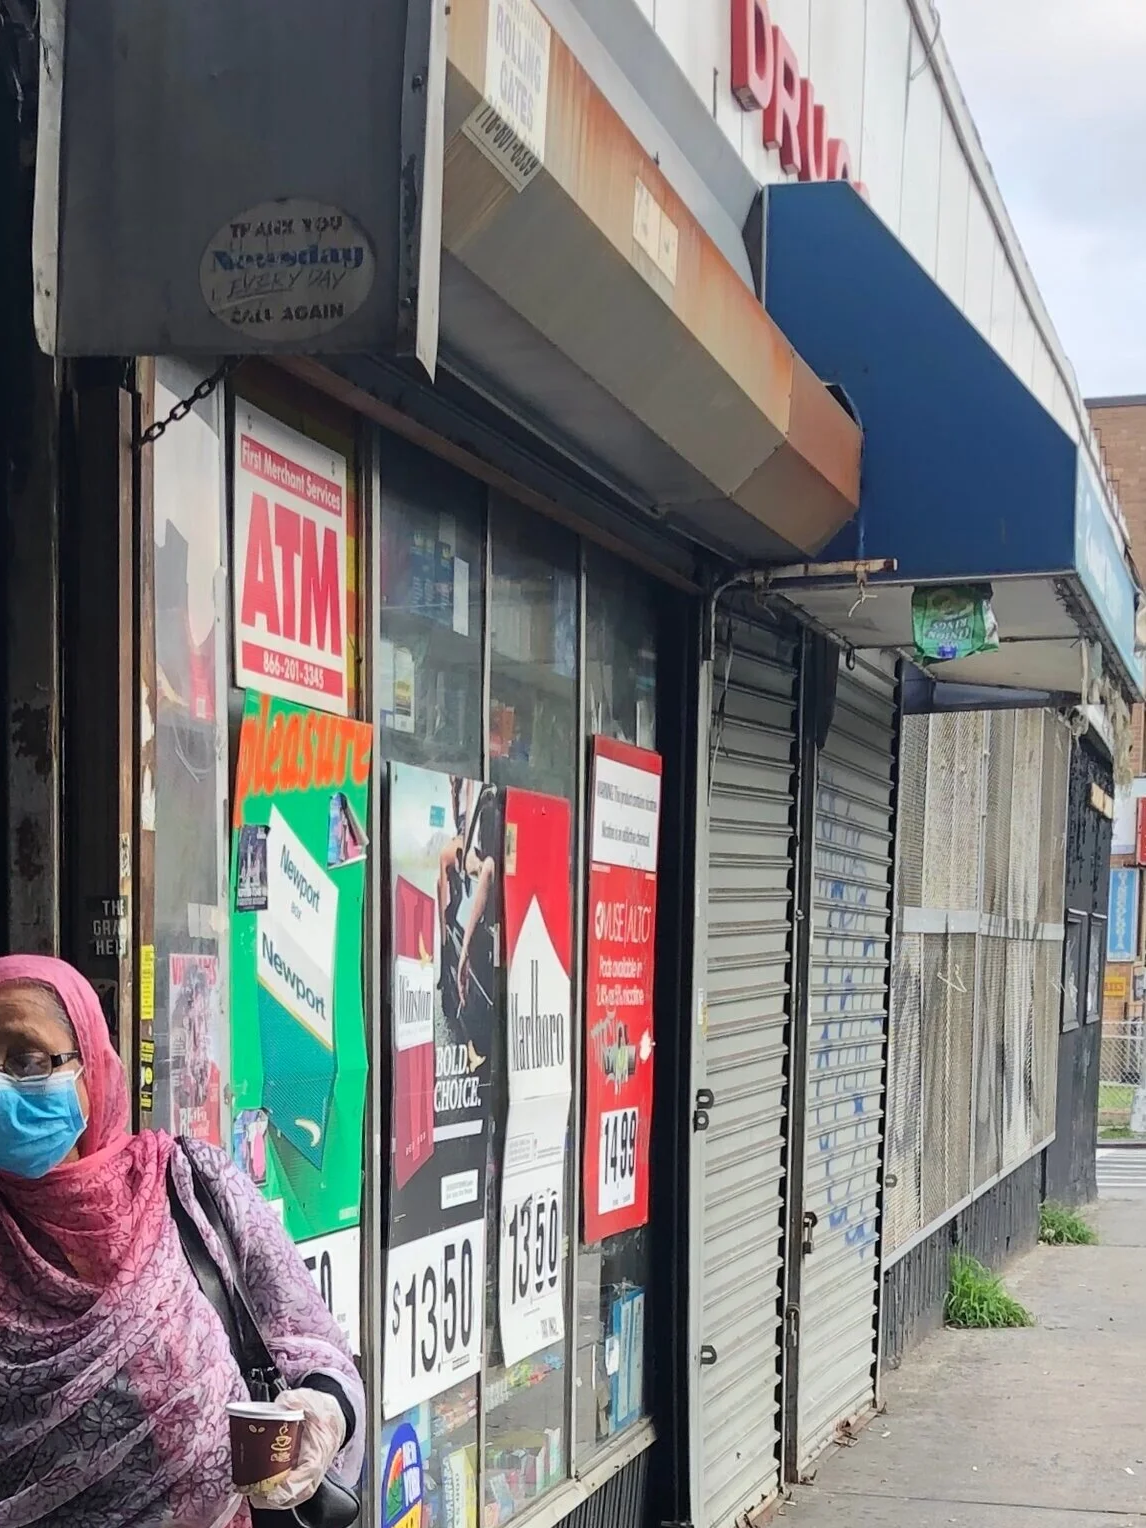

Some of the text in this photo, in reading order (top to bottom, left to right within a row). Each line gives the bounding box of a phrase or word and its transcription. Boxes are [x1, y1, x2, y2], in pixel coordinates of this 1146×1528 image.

[495, 4, 542, 95] ROLLING
[499, 59, 534, 133] GATES
[731, 0, 870, 202] DRU
[301, 215, 343, 233] YOU
[213, 243, 364, 271] Newsday
[281, 302, 345, 322] AGAIN
[242, 439, 341, 512] First Merchant Services
[241, 491, 342, 658] ATM
[279, 844, 320, 913] Newport
[290, 900, 303, 922] BOX
[603, 902, 652, 944] VUSE ALTO
[262, 931, 327, 1022] Newport
[399, 974, 432, 1025] Winston
[510, 959, 565, 1073] Marlboro
[435, 1043, 470, 1078] BOLD.
[434, 1076, 482, 1113] CHOICE.
